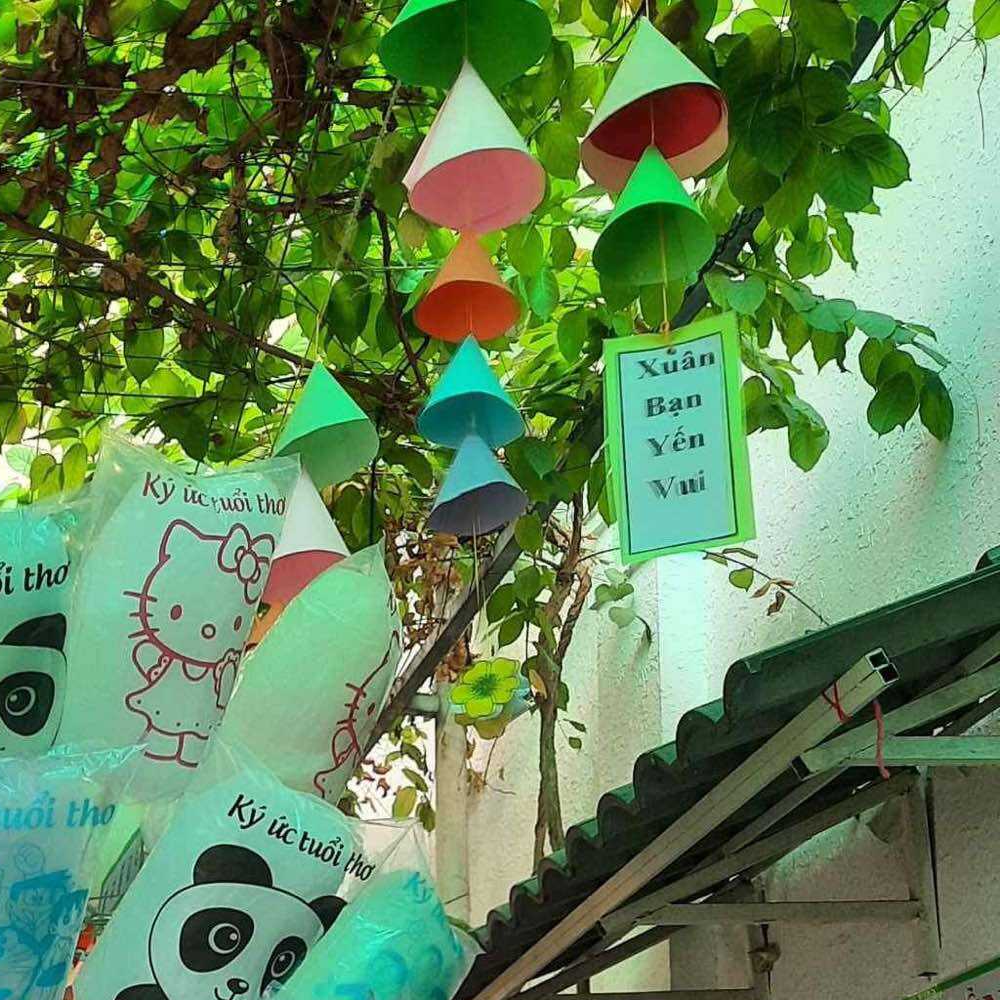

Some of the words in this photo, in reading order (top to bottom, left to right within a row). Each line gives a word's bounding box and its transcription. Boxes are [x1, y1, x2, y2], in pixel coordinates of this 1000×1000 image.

[638, 351, 716, 379] Xuân
[646, 393, 702, 418] Bạn
[143, 472, 175, 505] Ký
[183, 484, 209, 507] ức
[211, 487, 252, 516] tuổi
[256, 493, 287, 517] thơ
[648, 470, 706, 499] Vui
[23, 560, 72, 593] thơ
[227, 793, 267, 830] Ký
[267, 815, 298, 845] ức
[298, 831, 344, 867] tuổi
[343, 851, 376, 881] thơ
